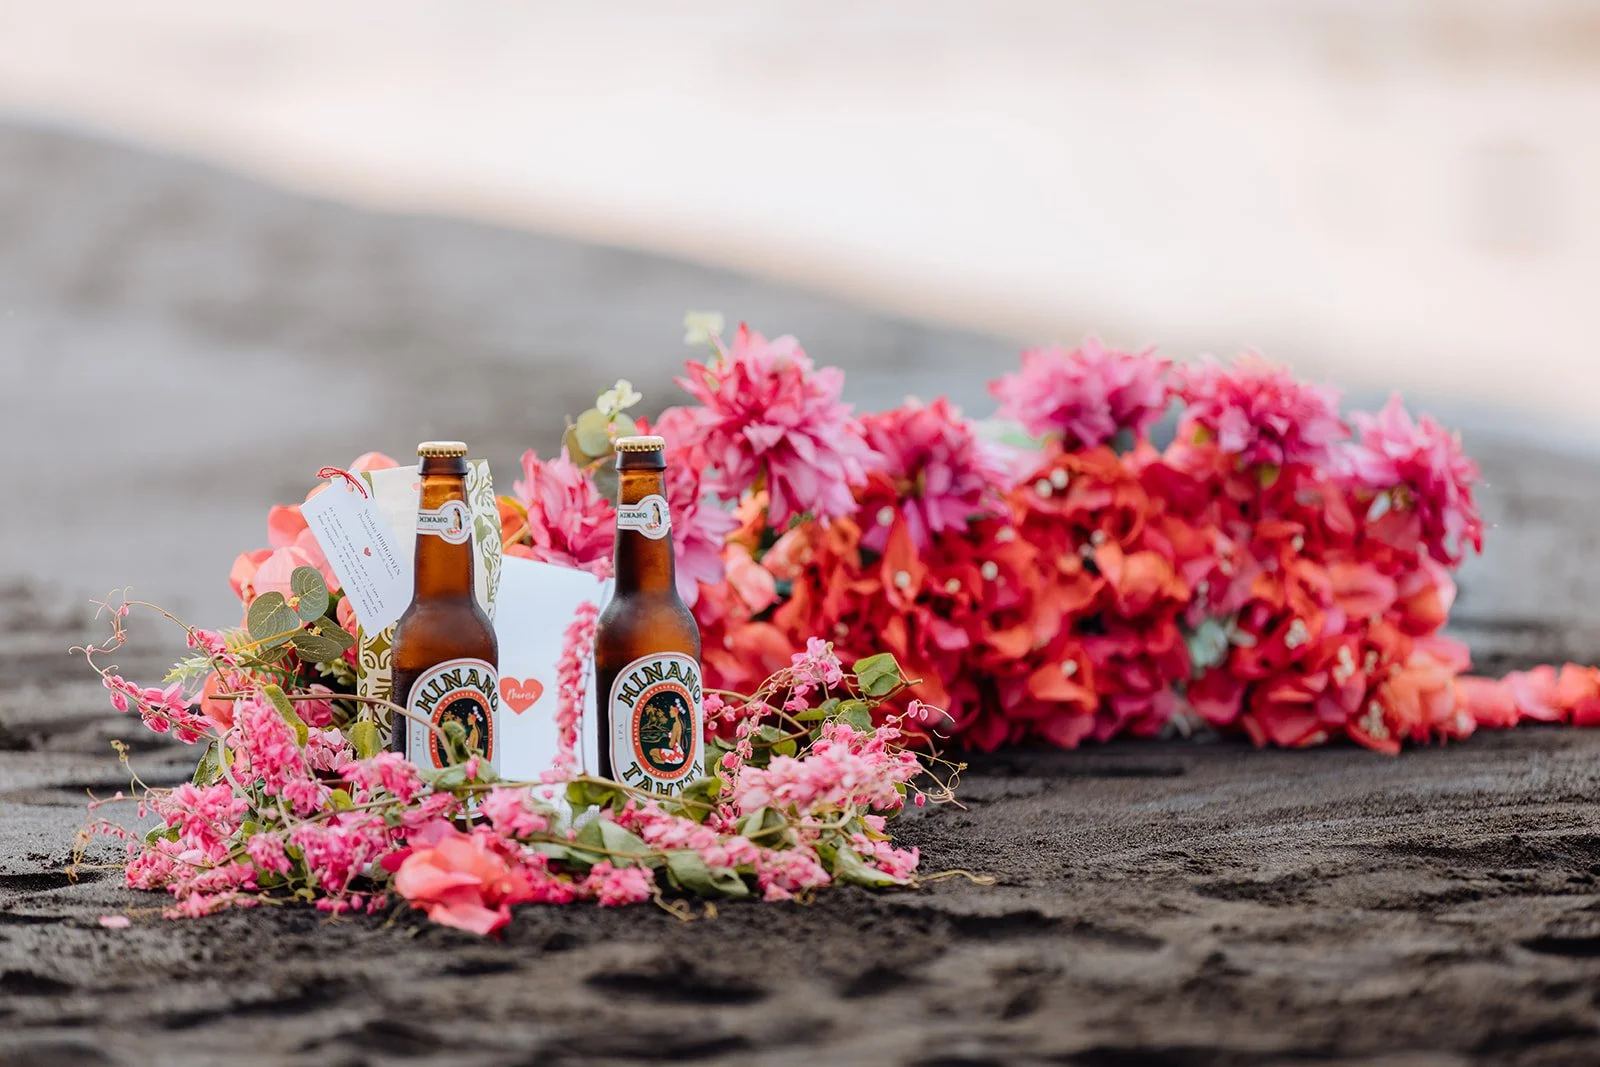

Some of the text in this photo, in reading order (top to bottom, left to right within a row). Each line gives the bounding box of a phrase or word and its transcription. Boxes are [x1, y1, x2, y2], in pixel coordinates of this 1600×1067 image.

[415, 668, 498, 715] HINANO
[506, 688, 537, 701] Merci
[617, 661, 702, 708] HINANO
